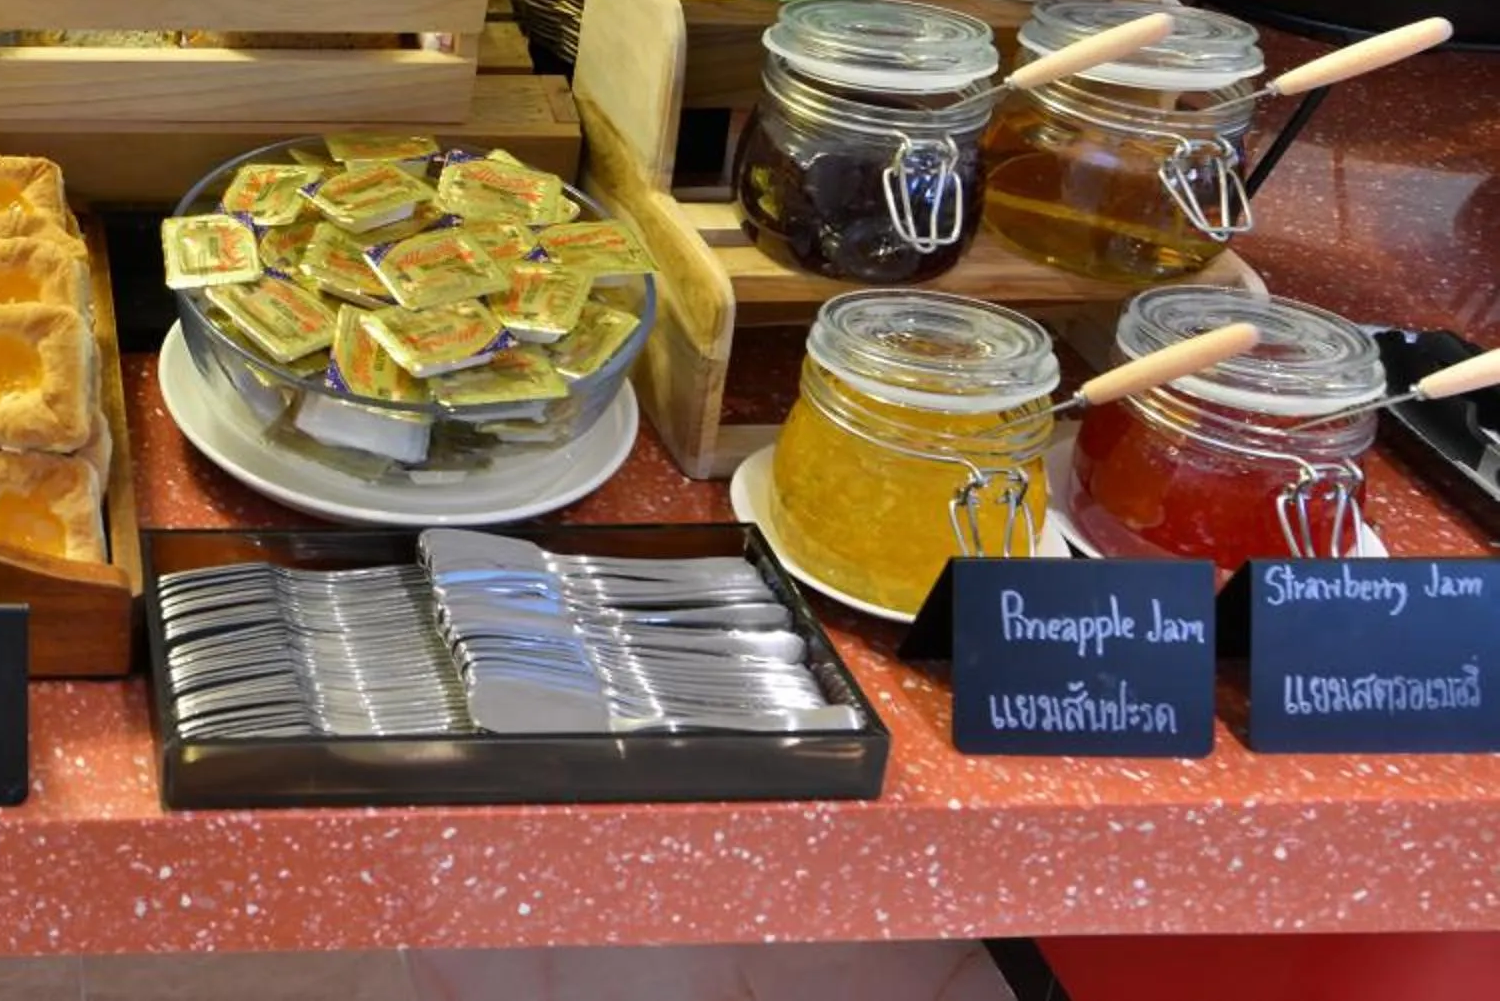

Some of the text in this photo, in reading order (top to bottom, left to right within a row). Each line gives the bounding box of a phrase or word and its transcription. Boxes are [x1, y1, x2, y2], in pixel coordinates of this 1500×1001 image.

[1424, 562, 1484, 598] Jam
[1001, 589, 1206, 657] Pineapple Jam
